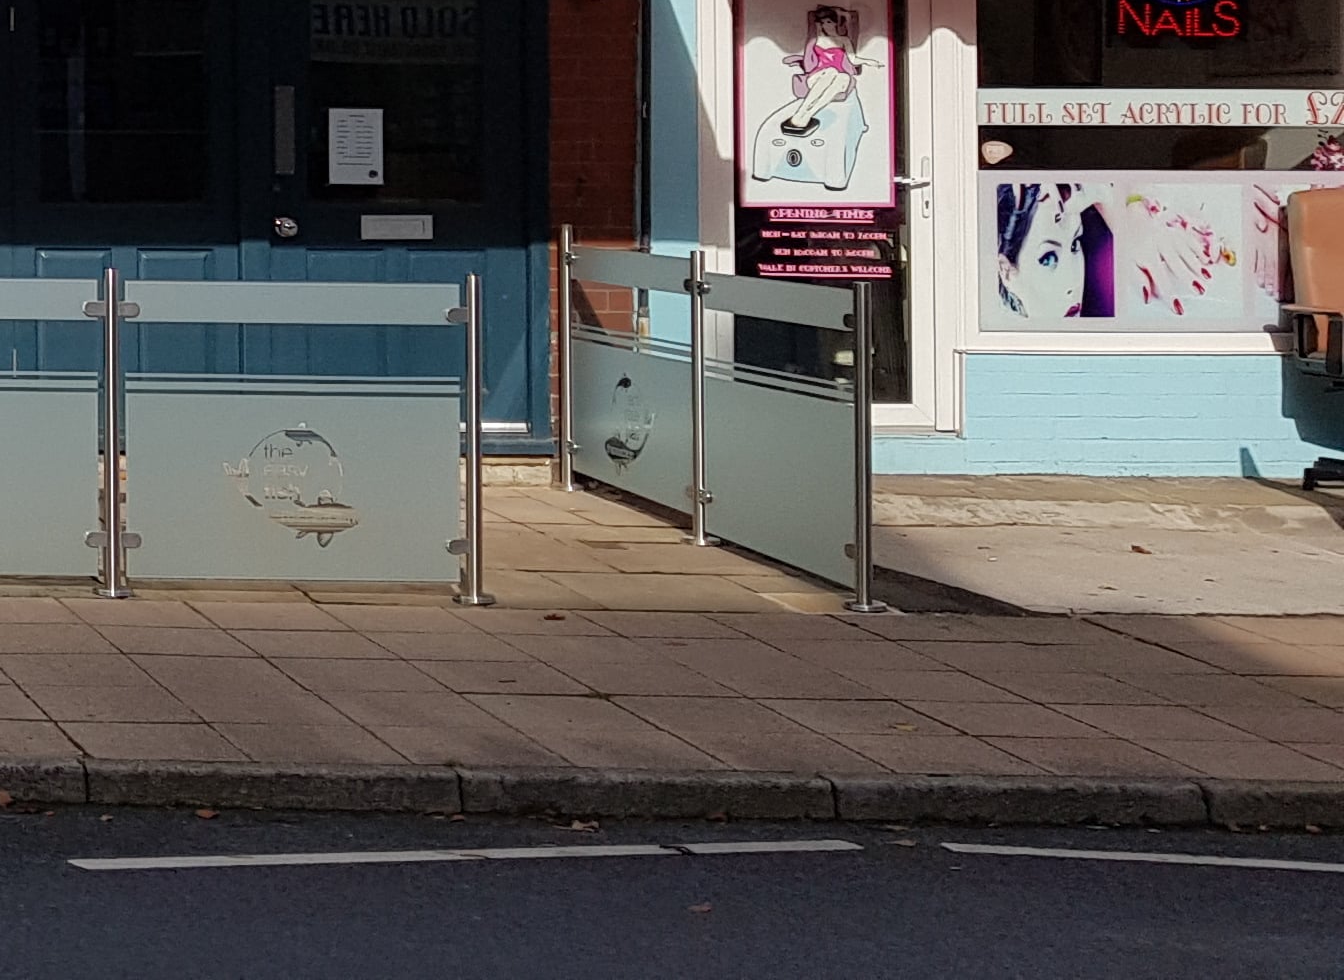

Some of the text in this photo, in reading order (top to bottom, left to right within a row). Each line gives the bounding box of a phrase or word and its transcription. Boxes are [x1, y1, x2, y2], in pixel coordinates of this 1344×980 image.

[984, 102, 1053, 125] FULL
[1062, 102, 1112, 125] SET
[1120, 101, 1232, 126] ACRYLIC
[1241, 103, 1291, 125] FOR
[832, 209, 875, 220] TIMES
